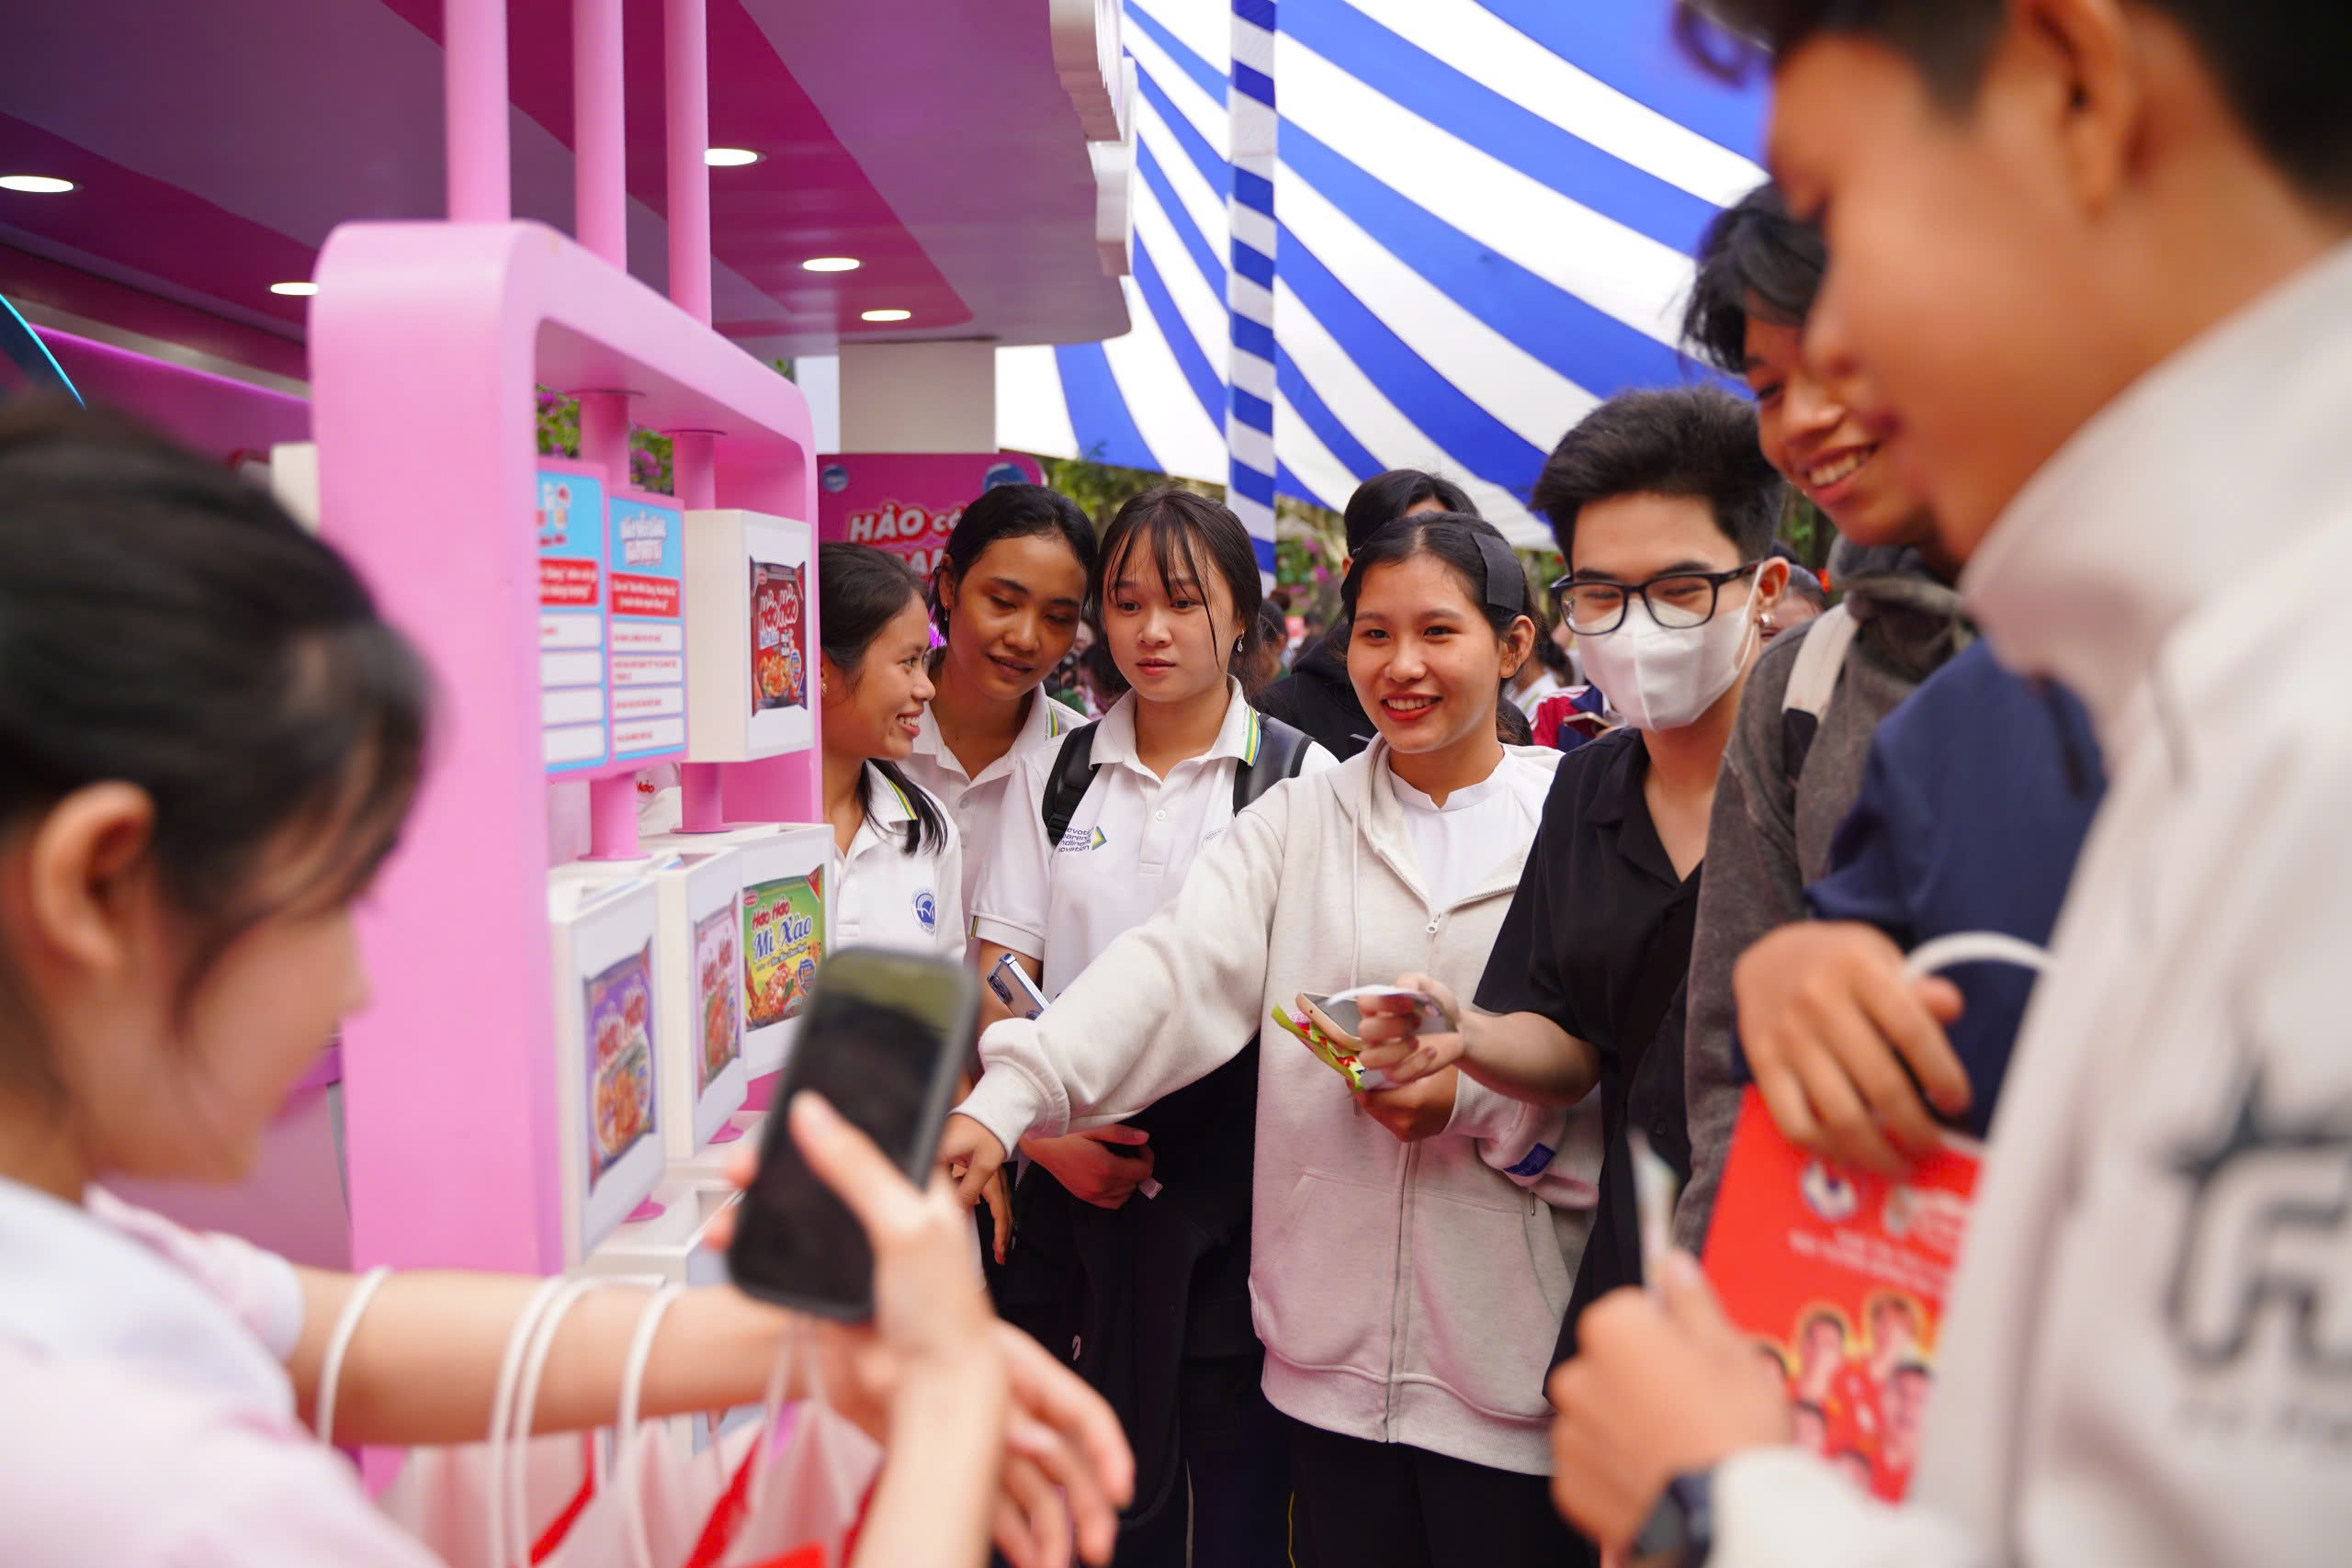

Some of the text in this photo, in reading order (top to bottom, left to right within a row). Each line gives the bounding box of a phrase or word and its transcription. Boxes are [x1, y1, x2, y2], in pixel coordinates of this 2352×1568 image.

[849, 505, 924, 541] HẢO
[753, 928, 774, 959] Mì
[779, 914, 812, 948] Xào
